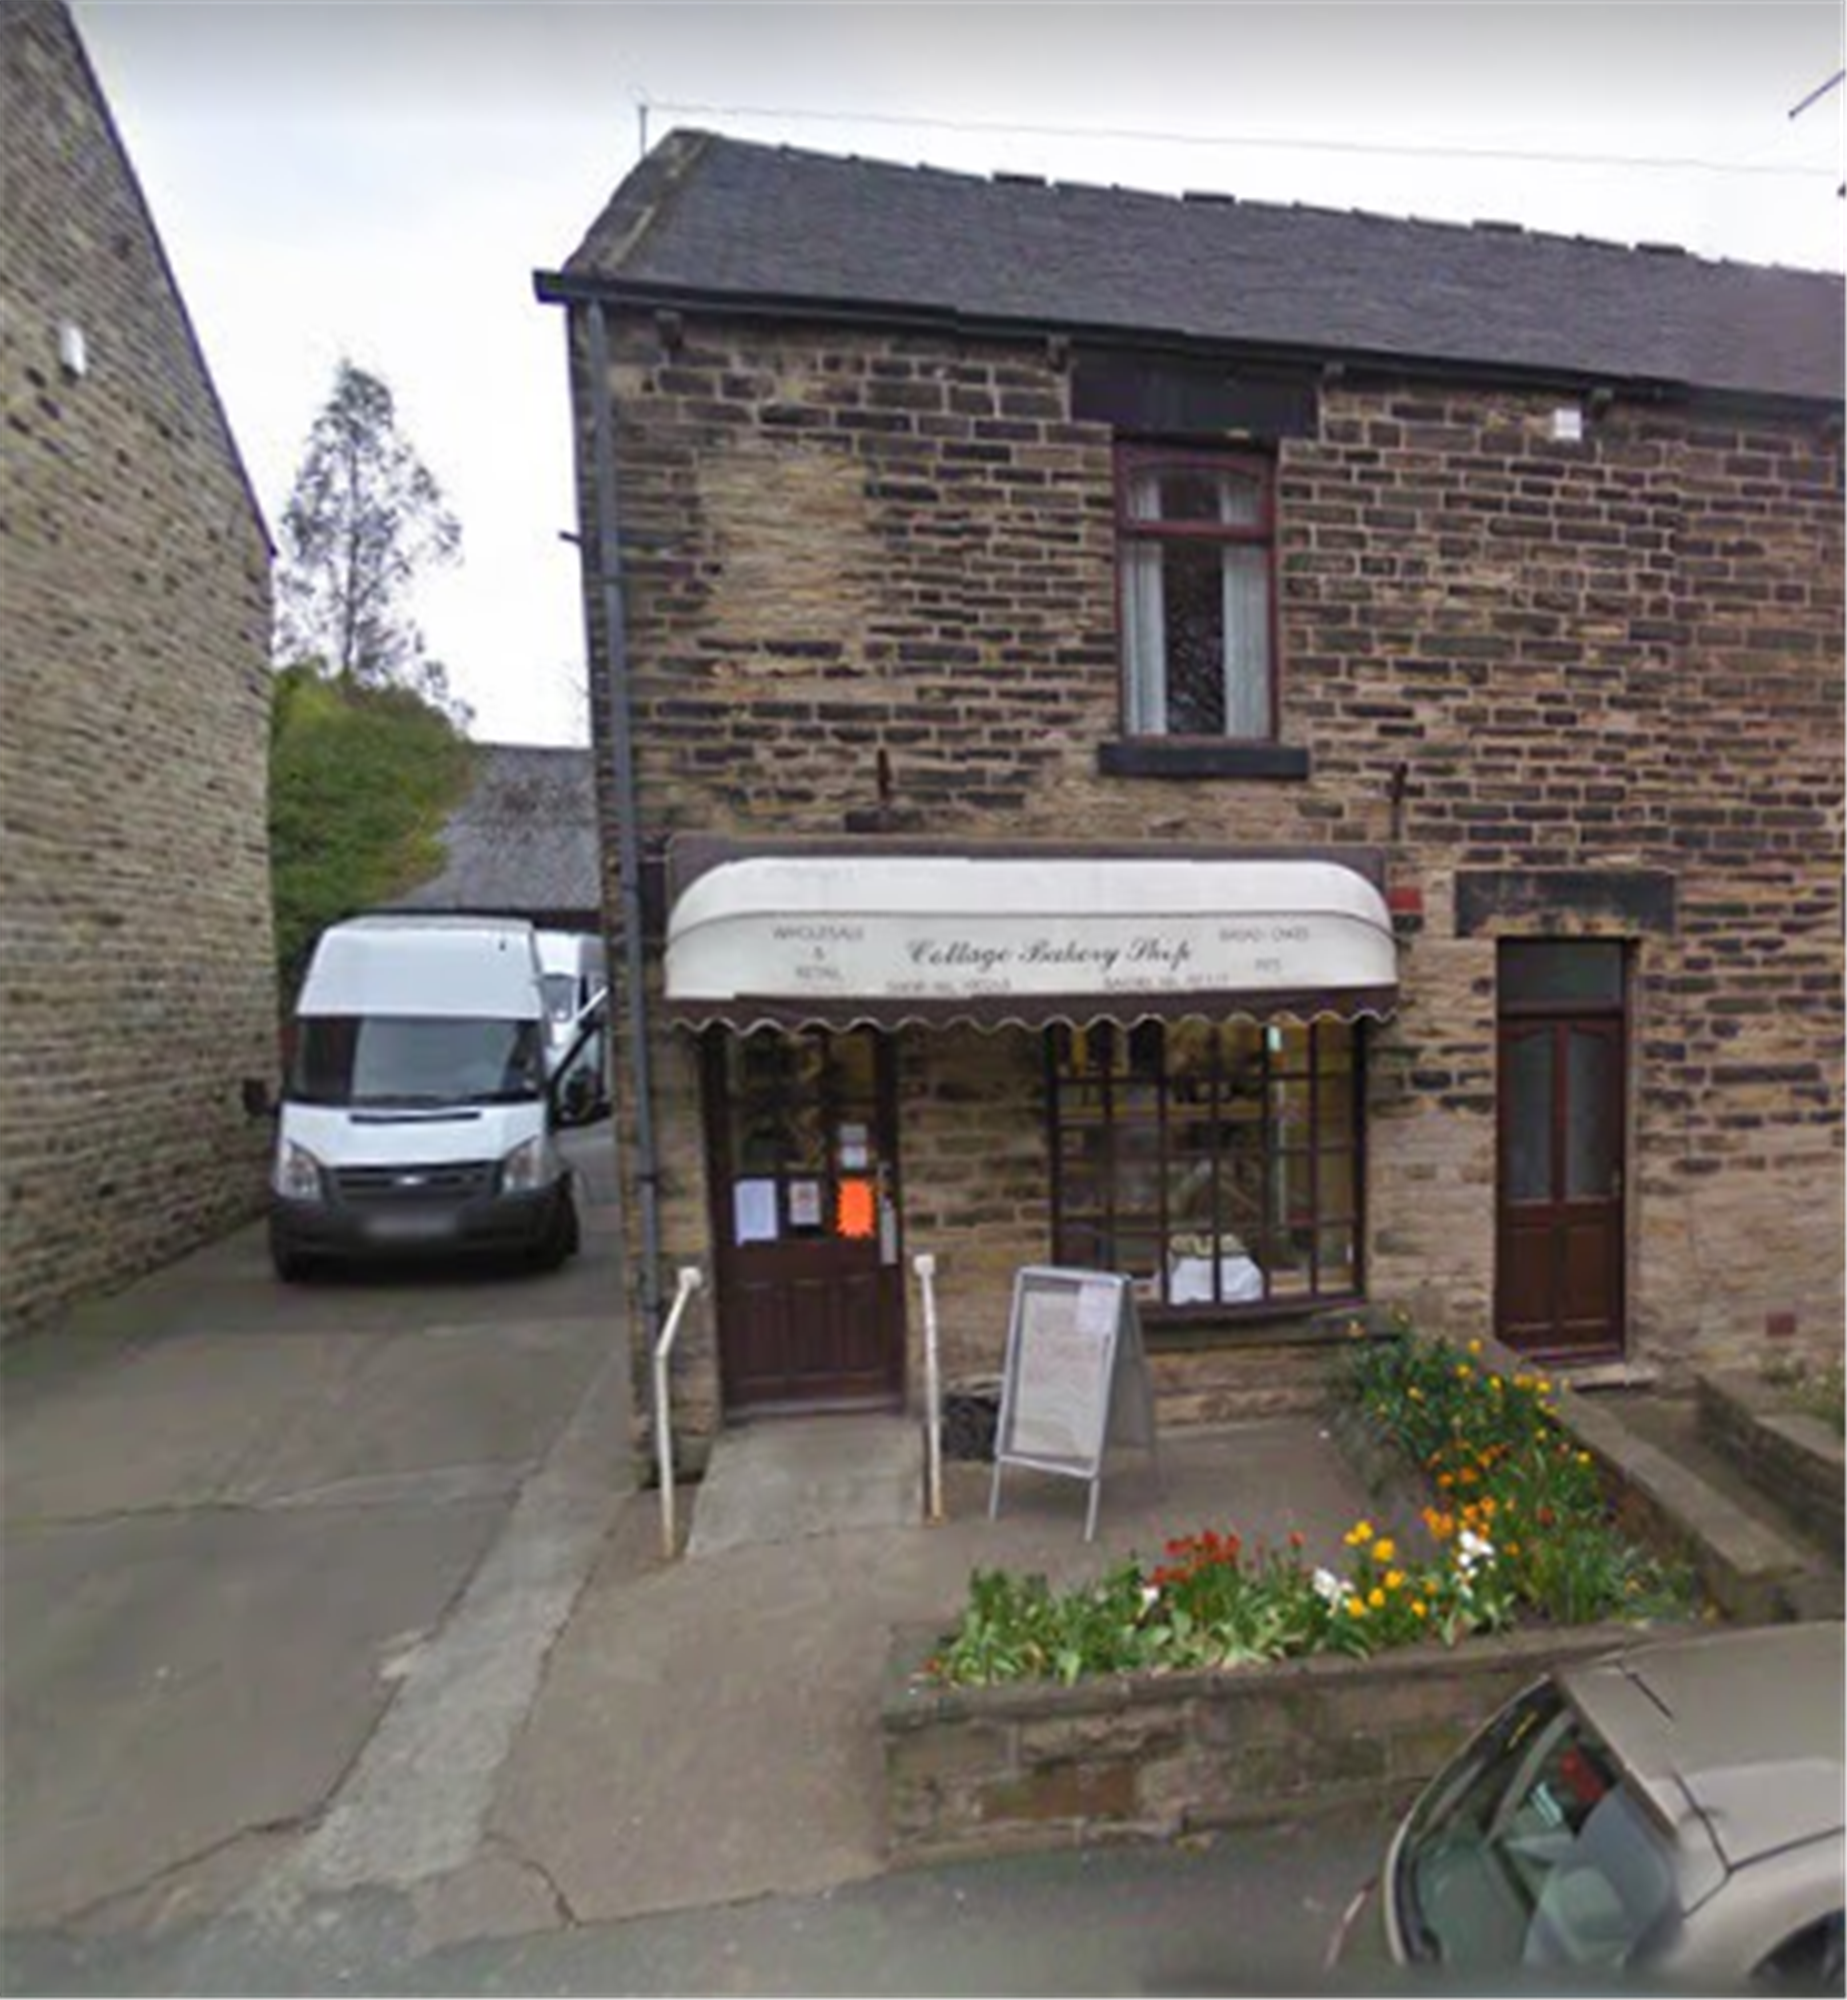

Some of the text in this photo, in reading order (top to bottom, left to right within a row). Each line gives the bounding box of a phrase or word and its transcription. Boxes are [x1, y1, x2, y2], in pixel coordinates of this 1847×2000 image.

[905, 935, 1192, 974] Cottage Bakery Shop
